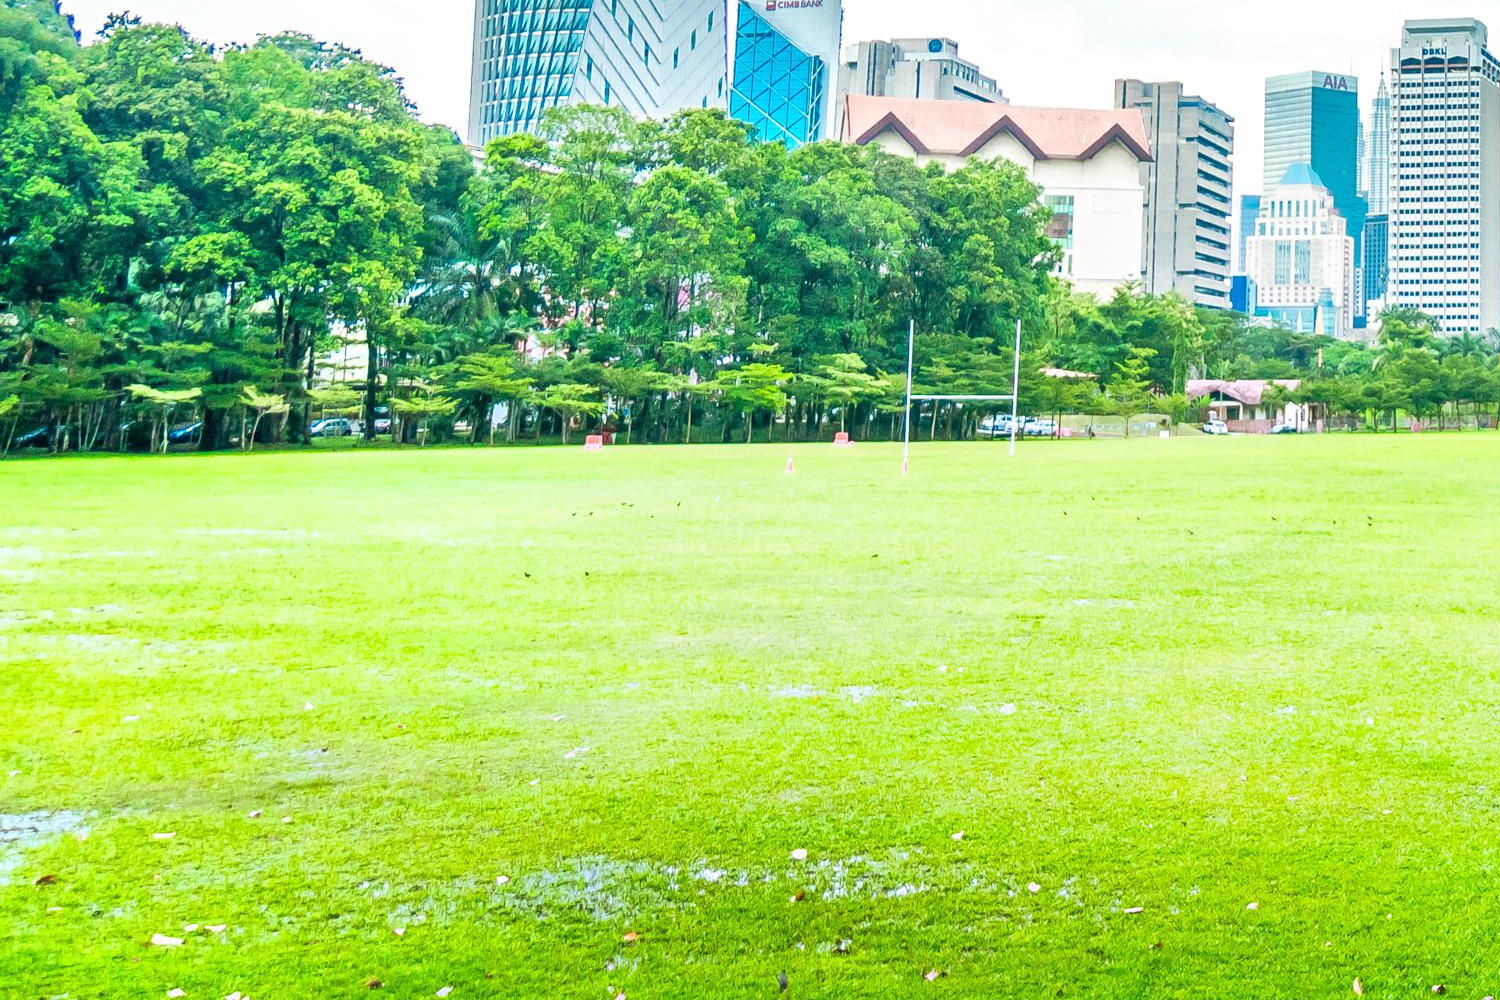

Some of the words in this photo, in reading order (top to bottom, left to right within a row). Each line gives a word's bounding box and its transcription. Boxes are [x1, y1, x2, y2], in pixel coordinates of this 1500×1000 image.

[778, 1, 800, 9] CIMB
[801, 0, 823, 8] BANK
[1422, 48, 1447, 56] DBKL
[1323, 74, 1348, 90] AIA
